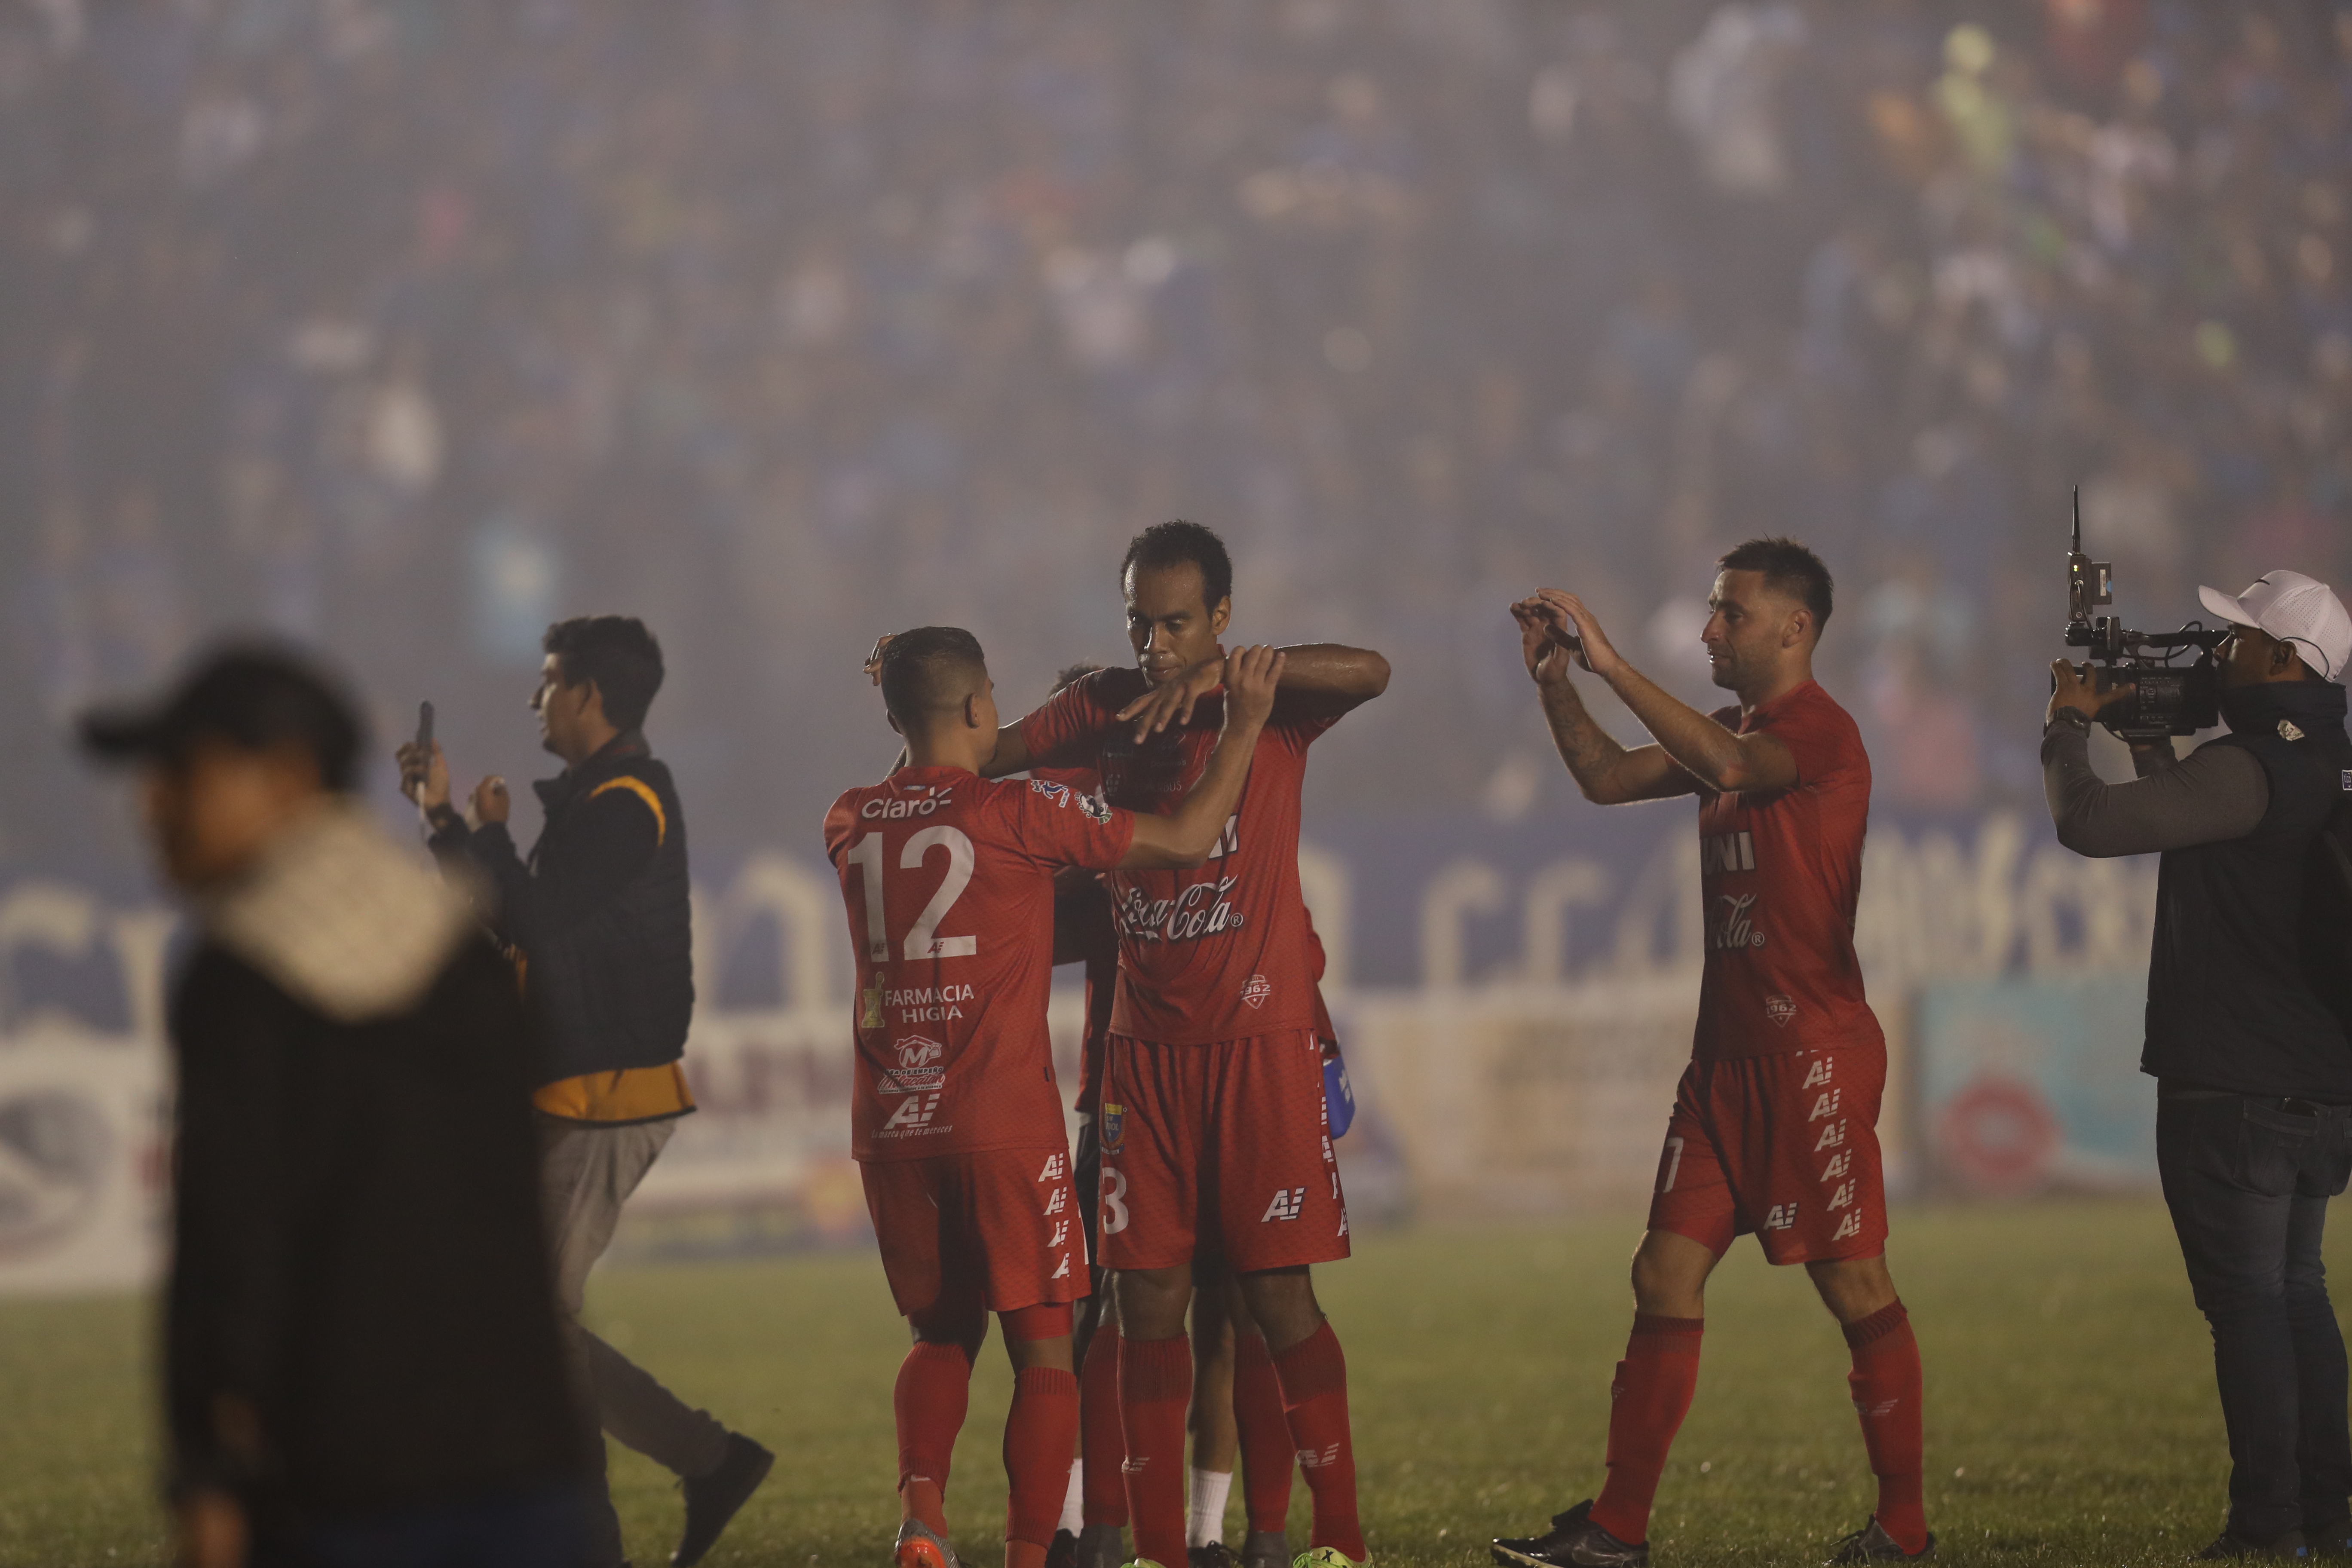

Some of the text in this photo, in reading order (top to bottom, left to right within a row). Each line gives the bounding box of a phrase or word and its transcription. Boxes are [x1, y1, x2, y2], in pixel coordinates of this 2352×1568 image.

[862, 796, 937, 818] Claro
[848, 826, 976, 962] 12
[885, 984, 974, 1006] FARMACIA
[1240, 984, 1271, 996] 1962
[902, 1004, 963, 1023] HIGIA
[1766, 1004, 1797, 1015] 1962
[901, 1047, 929, 1067] M
[900, 1129, 914, 1139] que
[915, 1127, 922, 1136] te
[923, 1125, 953, 1135] mereces
